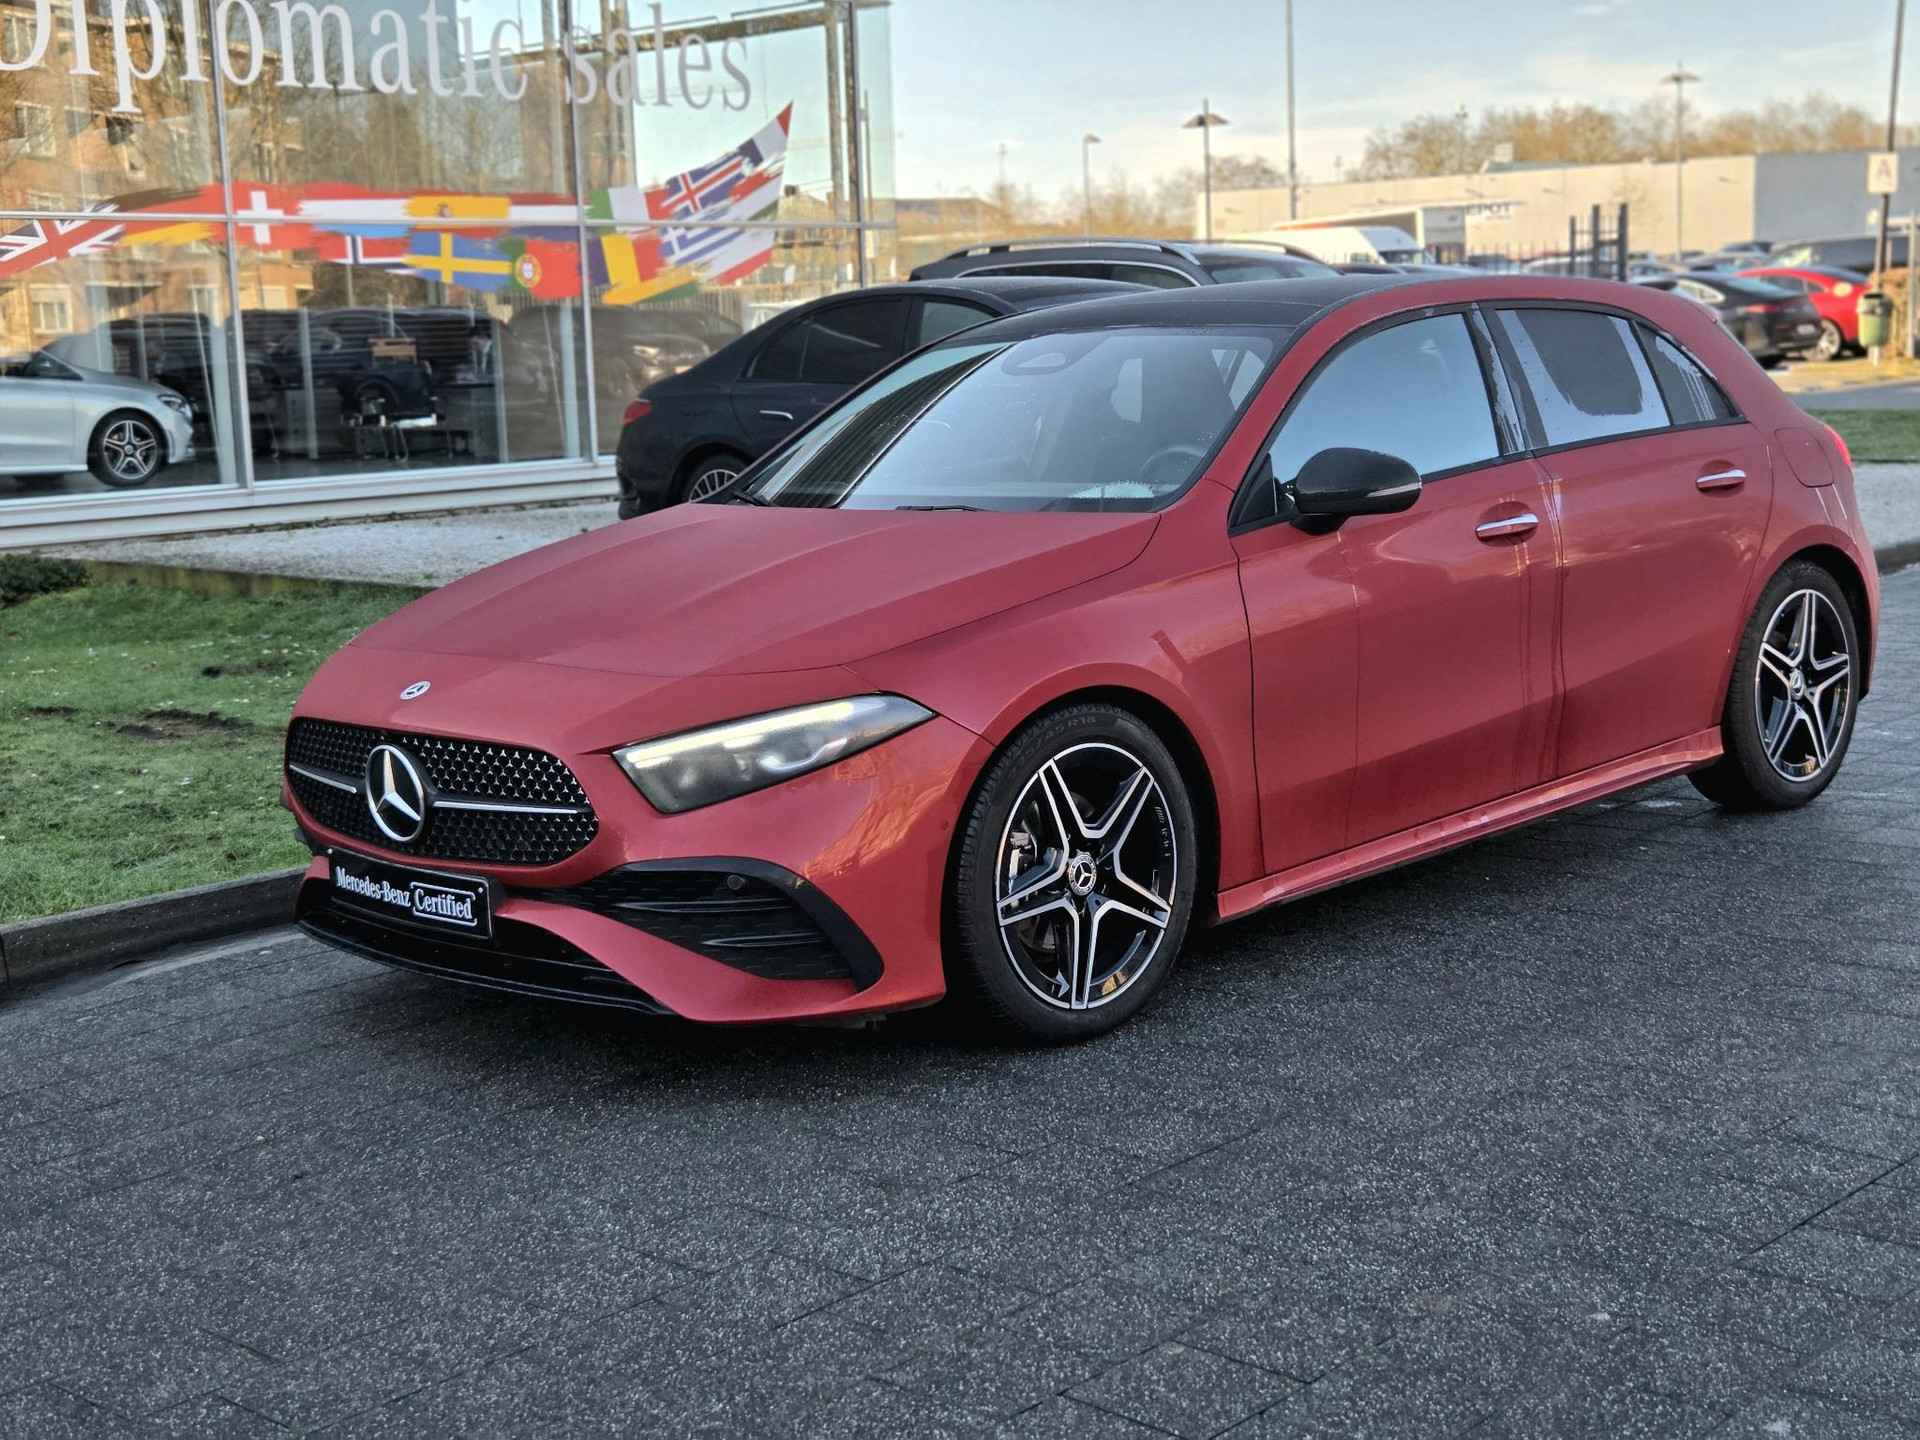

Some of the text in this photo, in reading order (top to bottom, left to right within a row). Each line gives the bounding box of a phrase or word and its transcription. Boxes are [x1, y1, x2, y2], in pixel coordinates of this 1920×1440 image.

[563, 2, 751, 111] sales
[335, 866, 473, 919] Mercedes-Benz Certified
